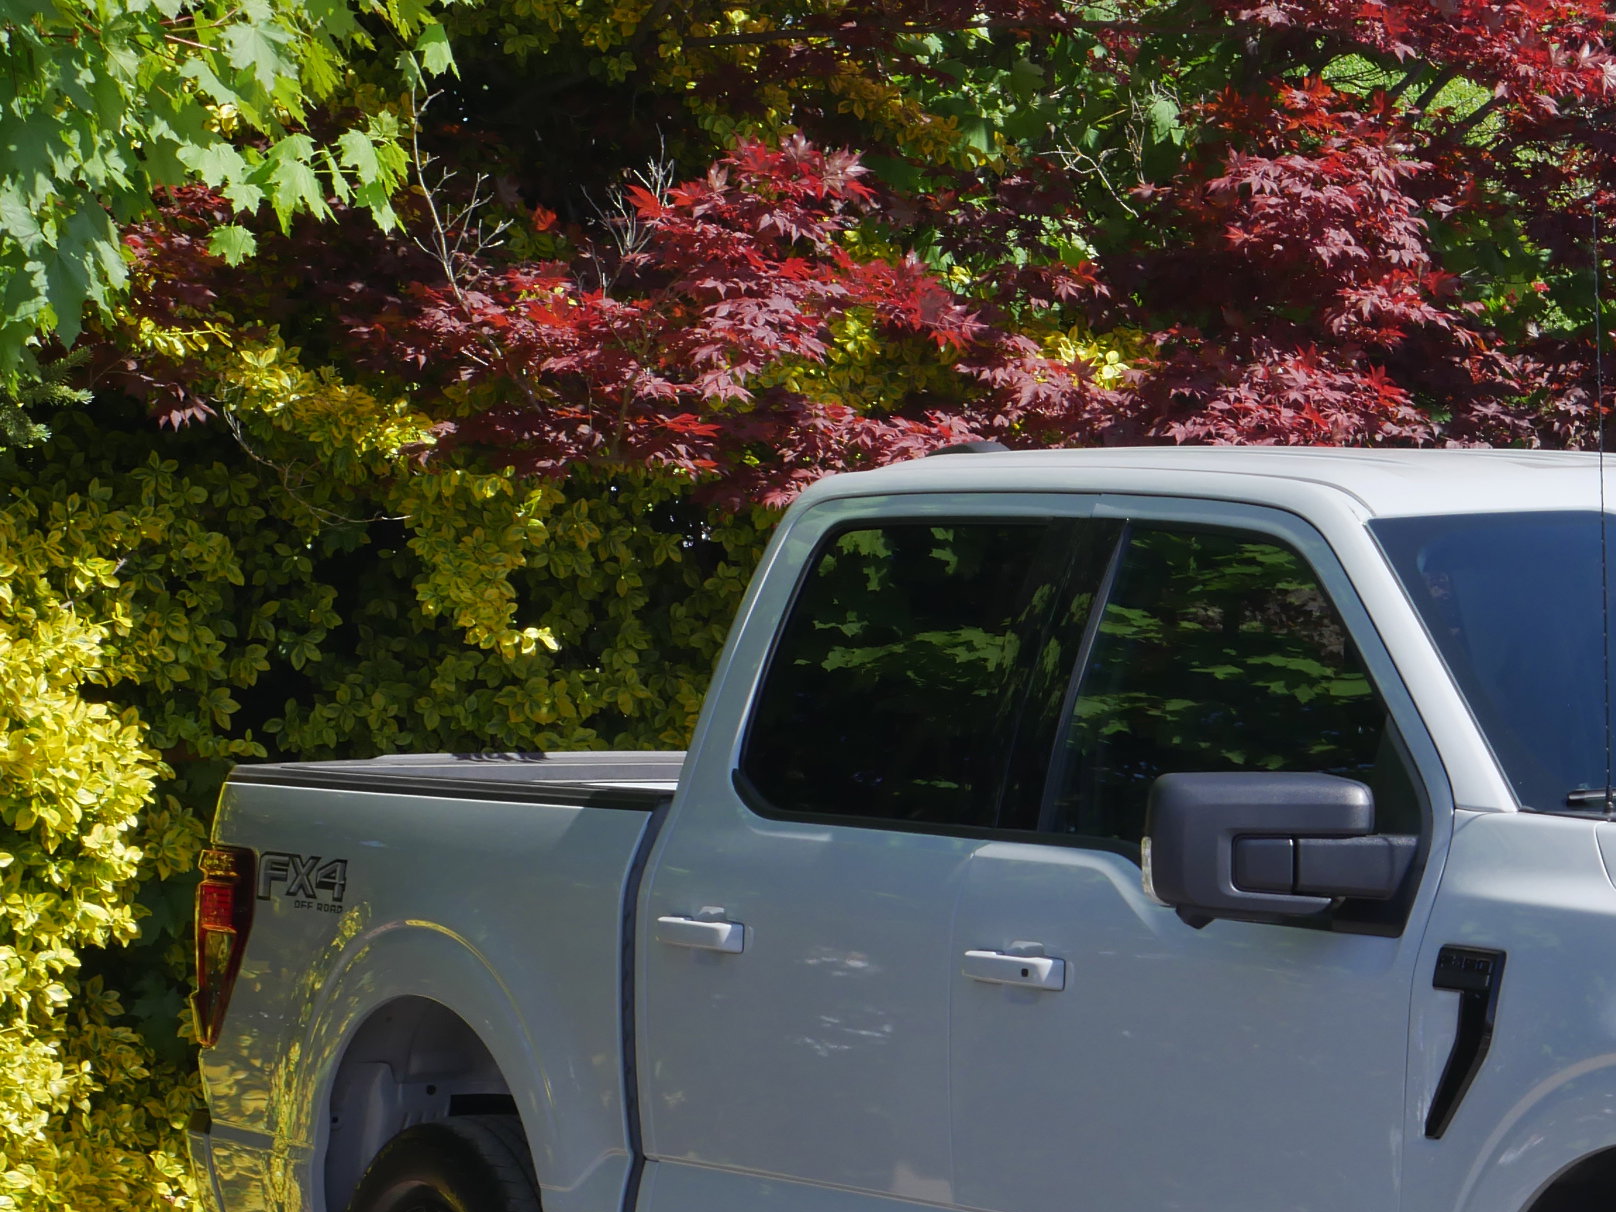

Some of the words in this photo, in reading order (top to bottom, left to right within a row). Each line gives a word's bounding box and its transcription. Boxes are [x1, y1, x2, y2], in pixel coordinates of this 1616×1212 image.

[257, 851, 348, 902] FX4
[294, 900, 314, 910] OFF
[316, 902, 344, 914] ROAD
